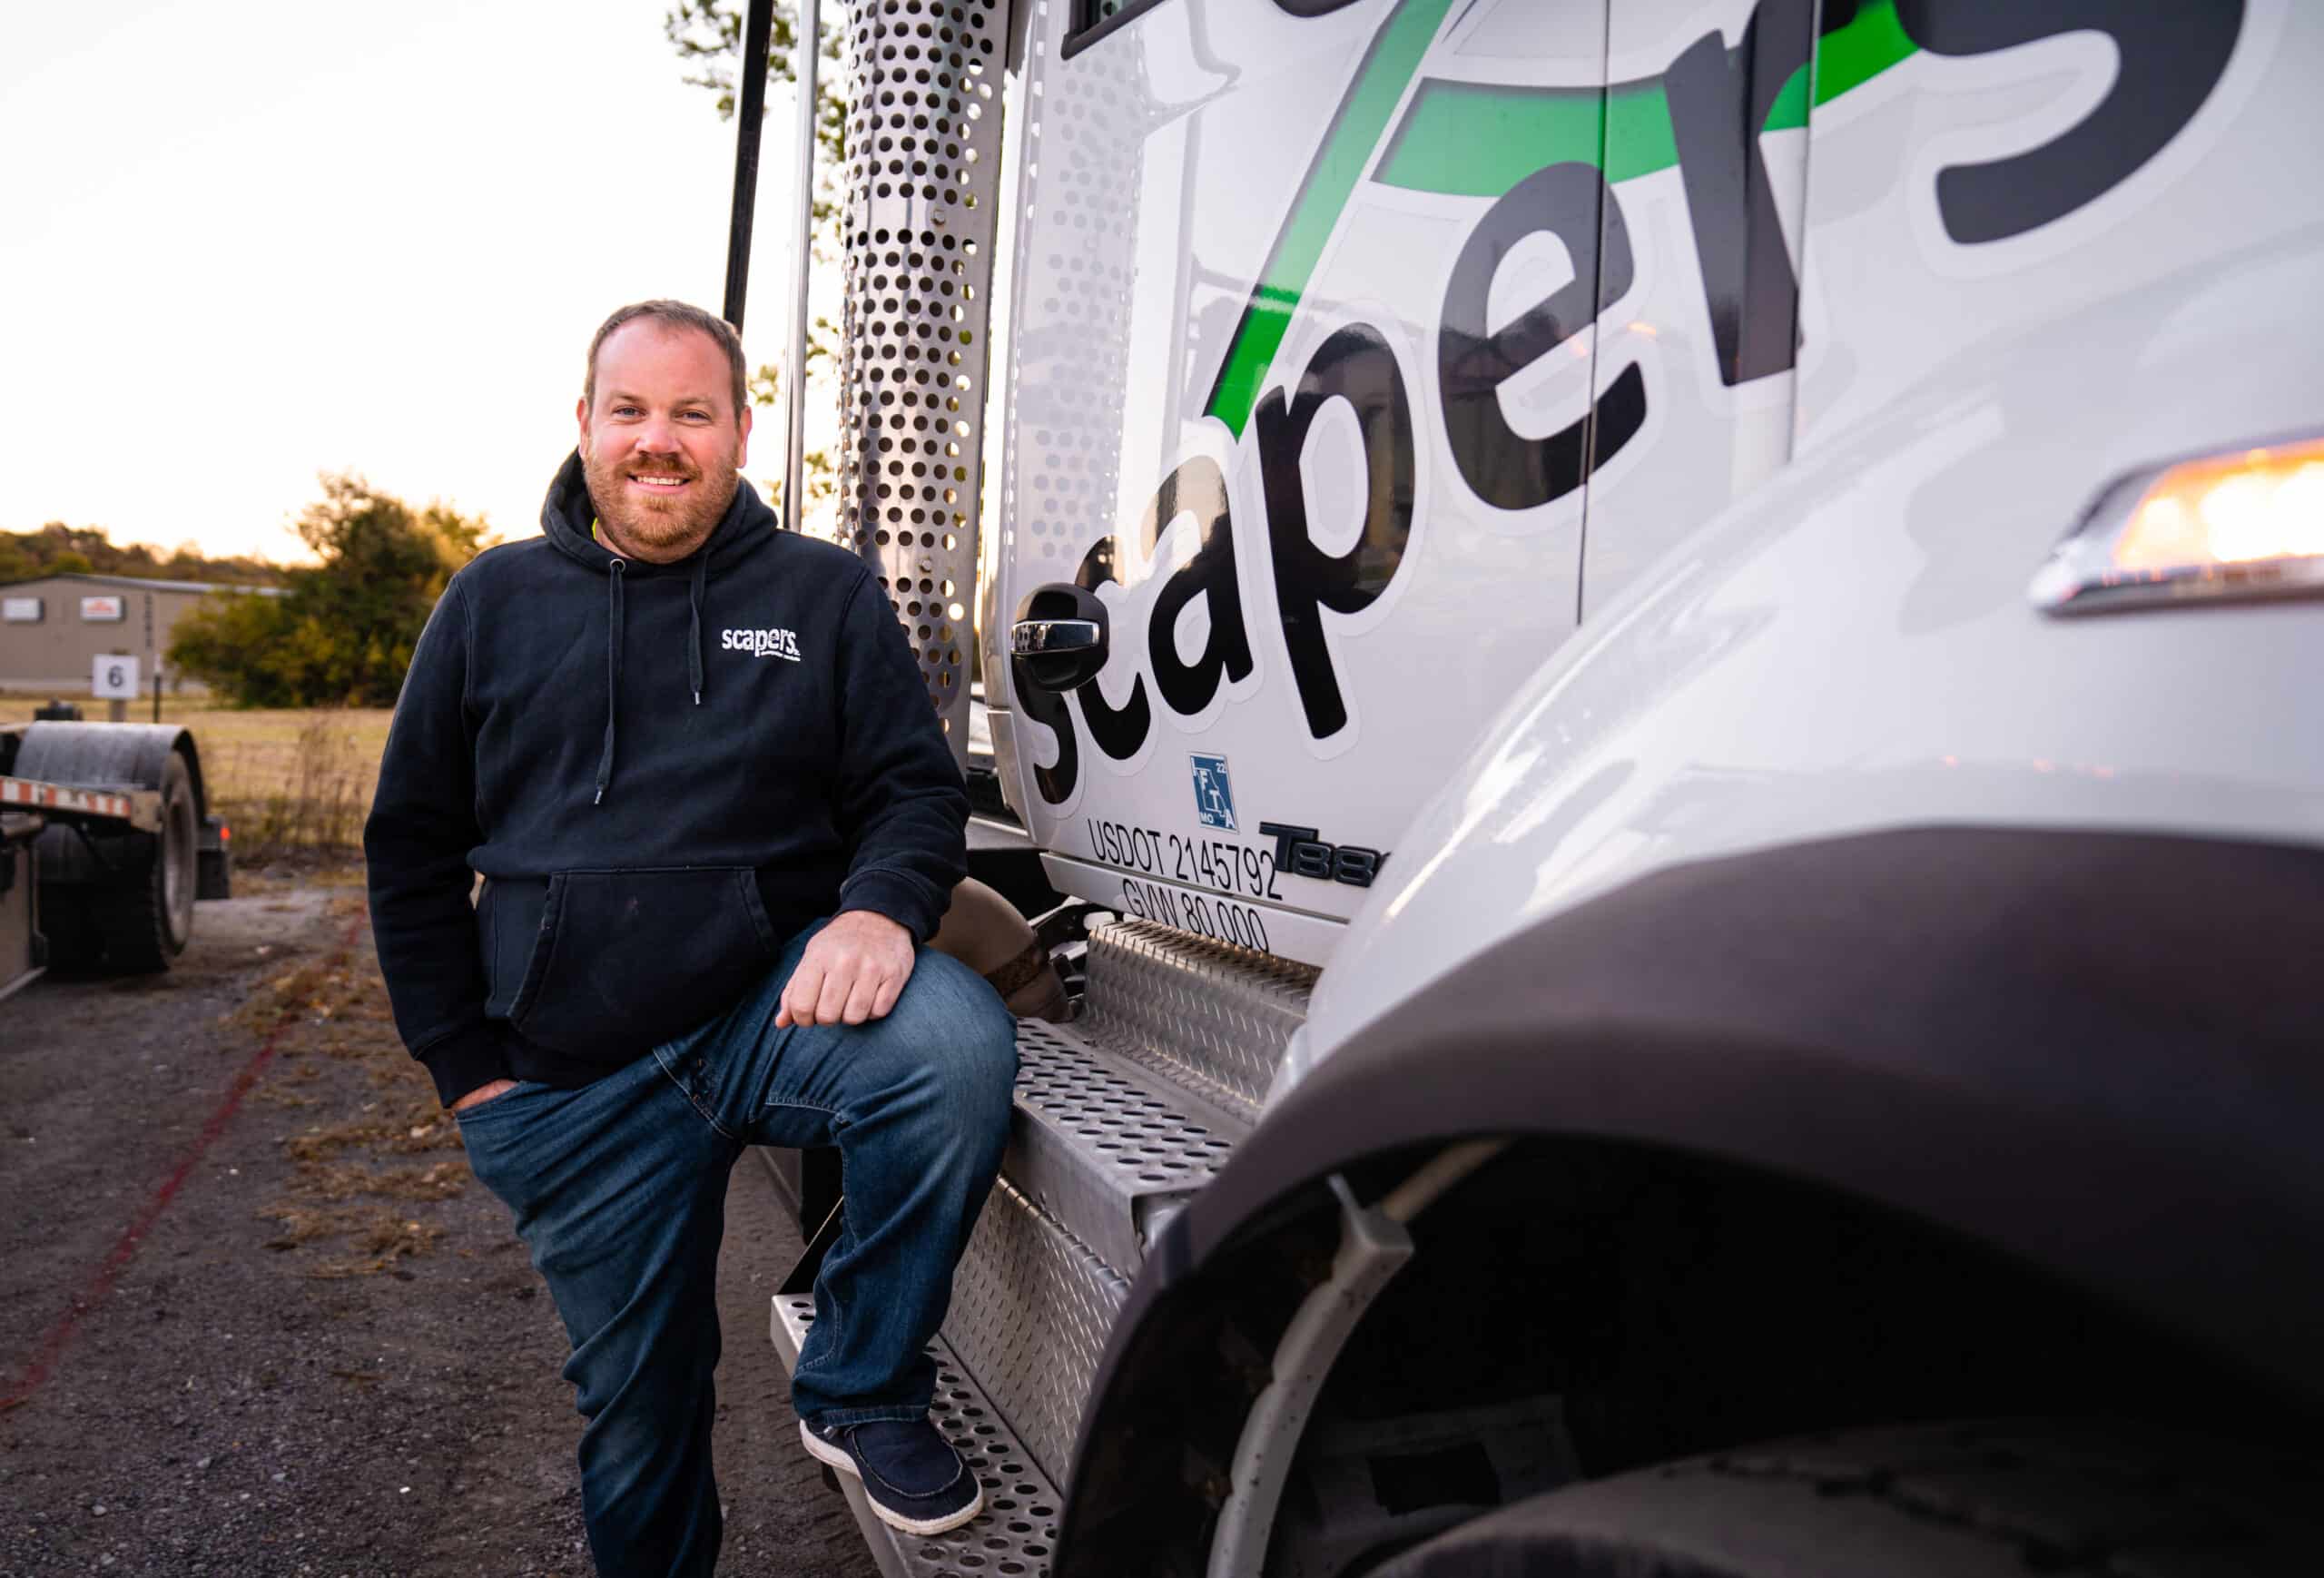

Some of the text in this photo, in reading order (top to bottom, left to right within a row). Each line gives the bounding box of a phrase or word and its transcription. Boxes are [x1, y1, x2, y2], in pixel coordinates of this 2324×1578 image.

[721, 628, 801, 658] scapers
[108, 665, 124, 688] 6
[1216, 762, 1227, 774] 22
[1199, 812, 1215, 824] MO
[1088, 818, 1283, 902] USDOT 2145792
[1259, 821, 1391, 888] T88
[1122, 878, 1180, 930] GVW
